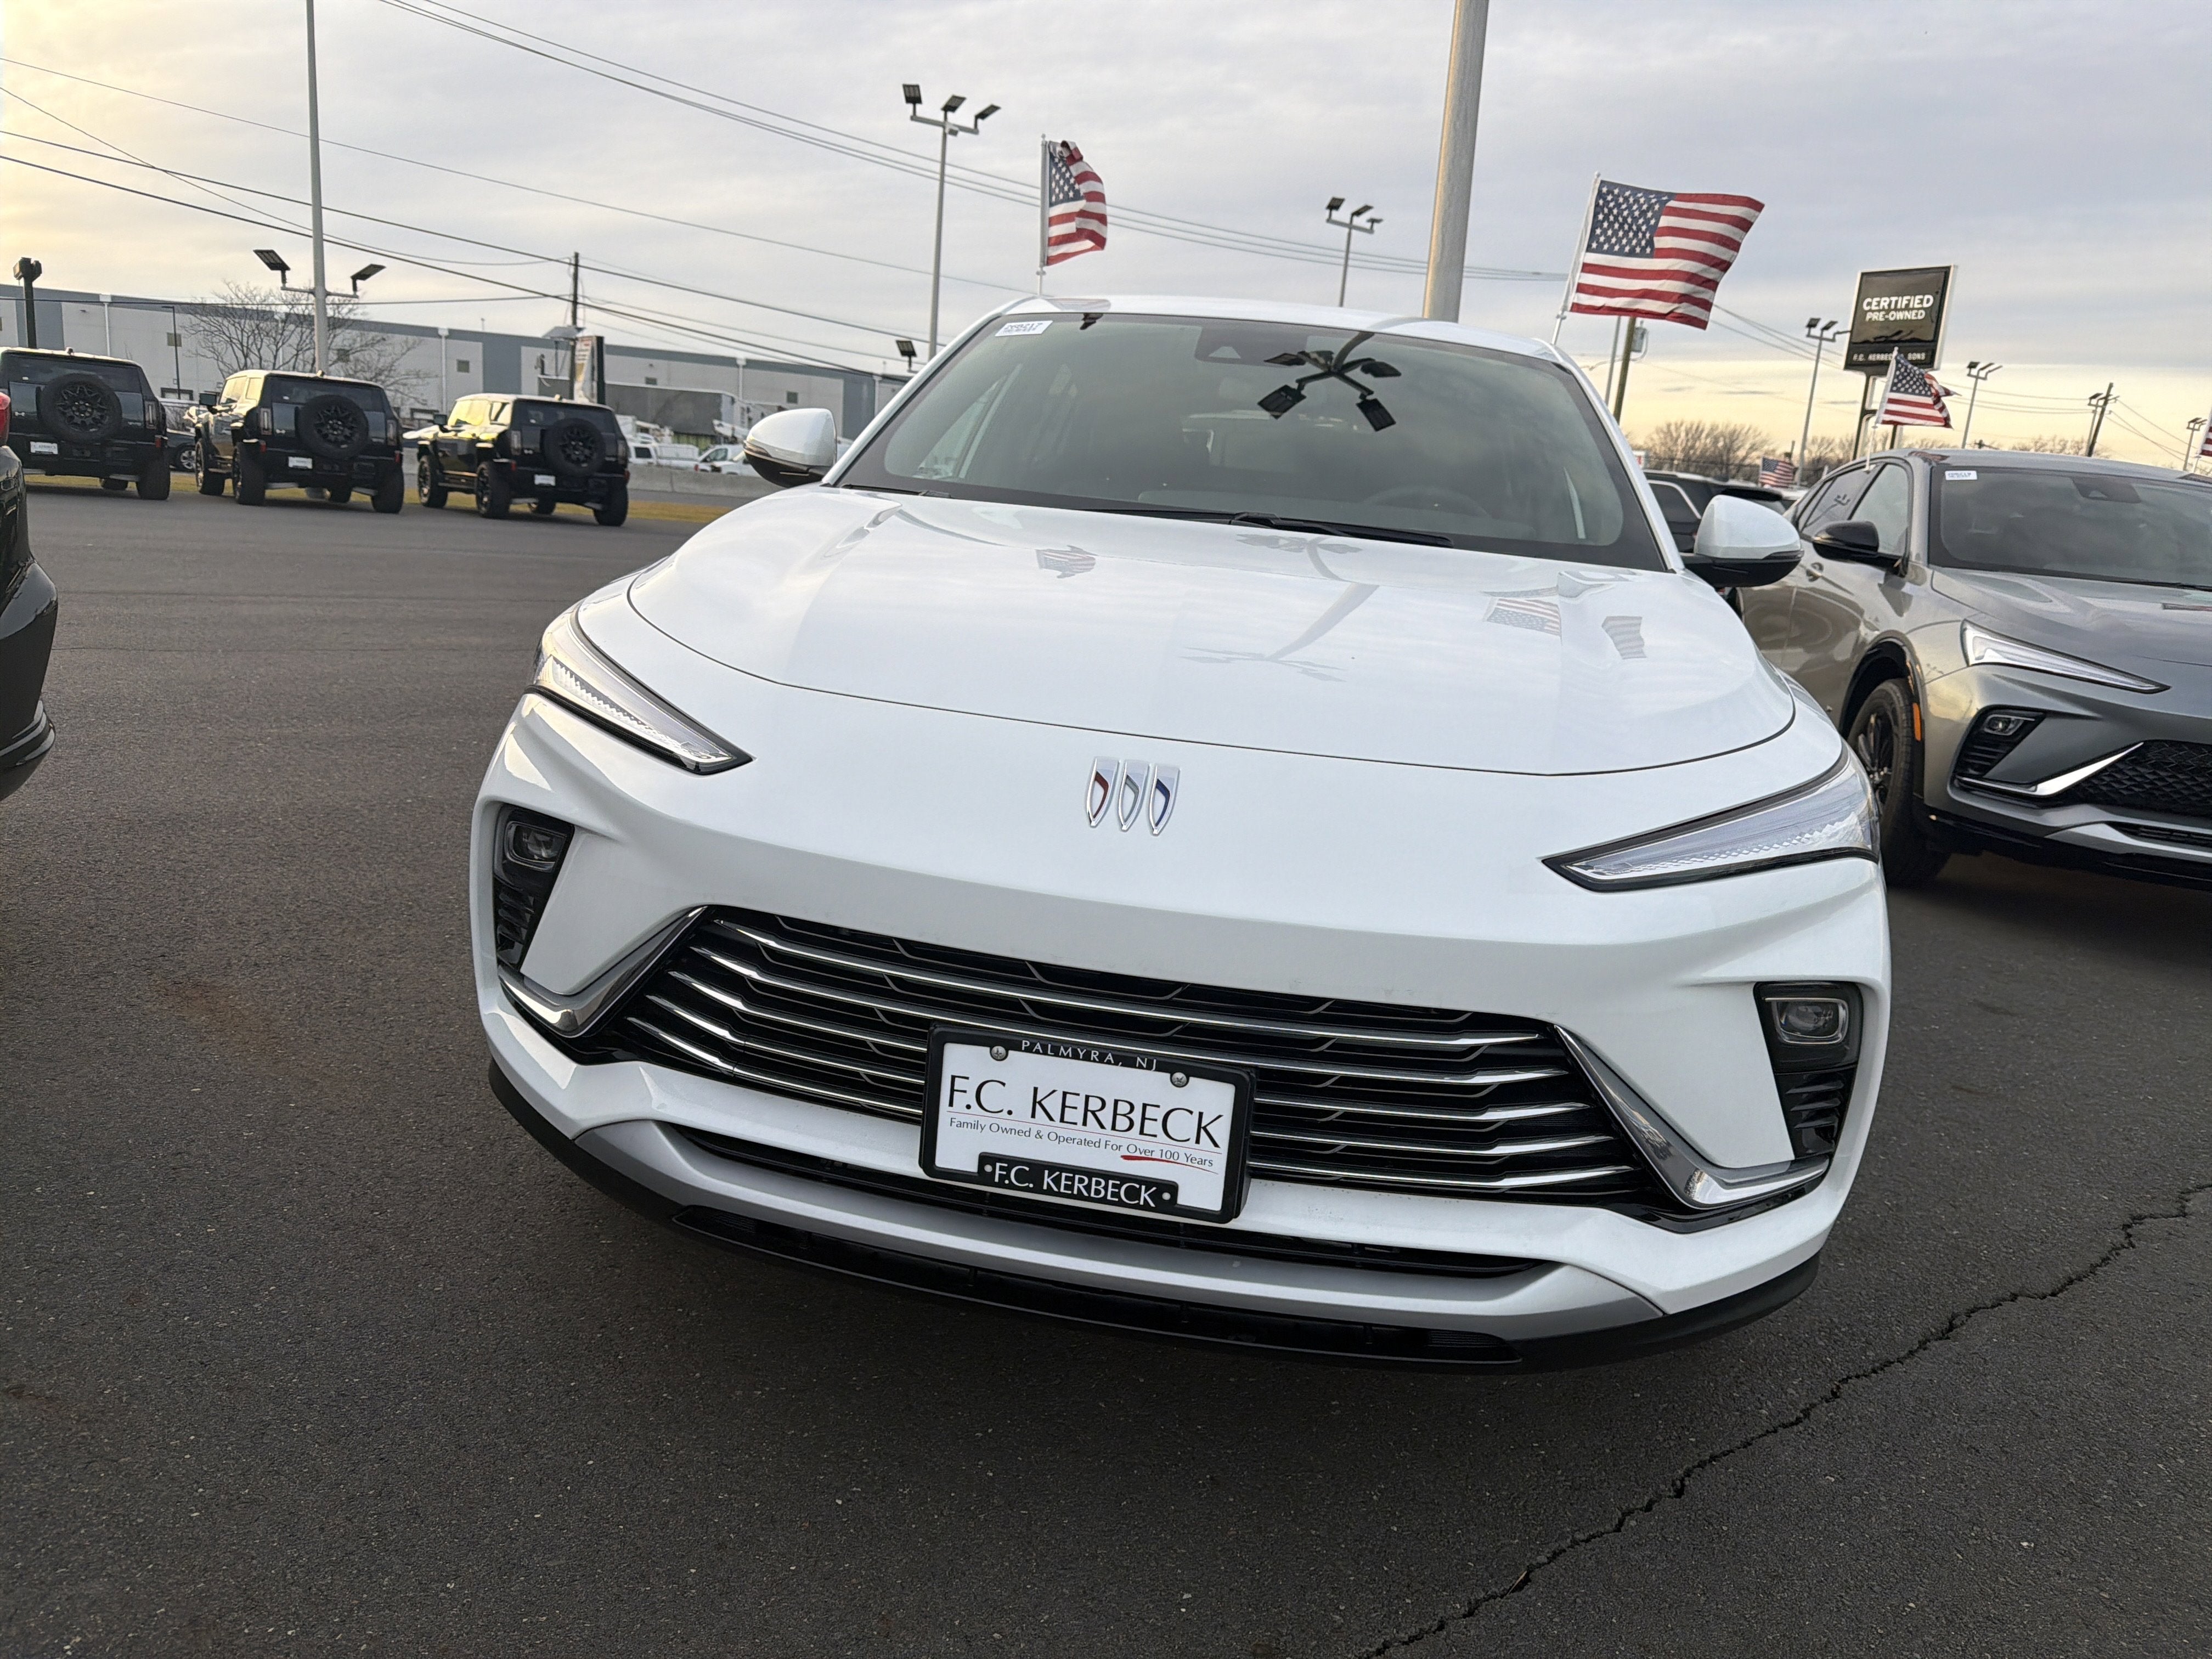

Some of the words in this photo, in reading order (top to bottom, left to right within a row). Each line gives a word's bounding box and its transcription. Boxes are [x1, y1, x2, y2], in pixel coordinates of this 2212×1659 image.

[1863, 295, 1934, 311] CERTIFIED
[1865, 310, 1926, 321] PRE-OWNED
[1867, 353, 1893, 361] KERBEC
[1136, 1056, 1157, 1071] NJ
[948, 1074, 1013, 1116] F.C.
[1030, 1086, 1224, 1149] KERBECK
[950, 1117, 986, 1133] Family
[989, 1122, 1031, 1138] Owned
[1035, 1129, 1043, 1139] &
[1047, 1131, 1101, 1148] Operated
[1104, 1140, 1123, 1152] For
[1126, 1143, 1155, 1157] Over
[1159, 1149, 1180, 1161] 100
[1184, 1153, 1213, 1167] Years
[994, 1162, 1034, 1188] F.C.
[1043, 1170, 1157, 1207] KERBECK
